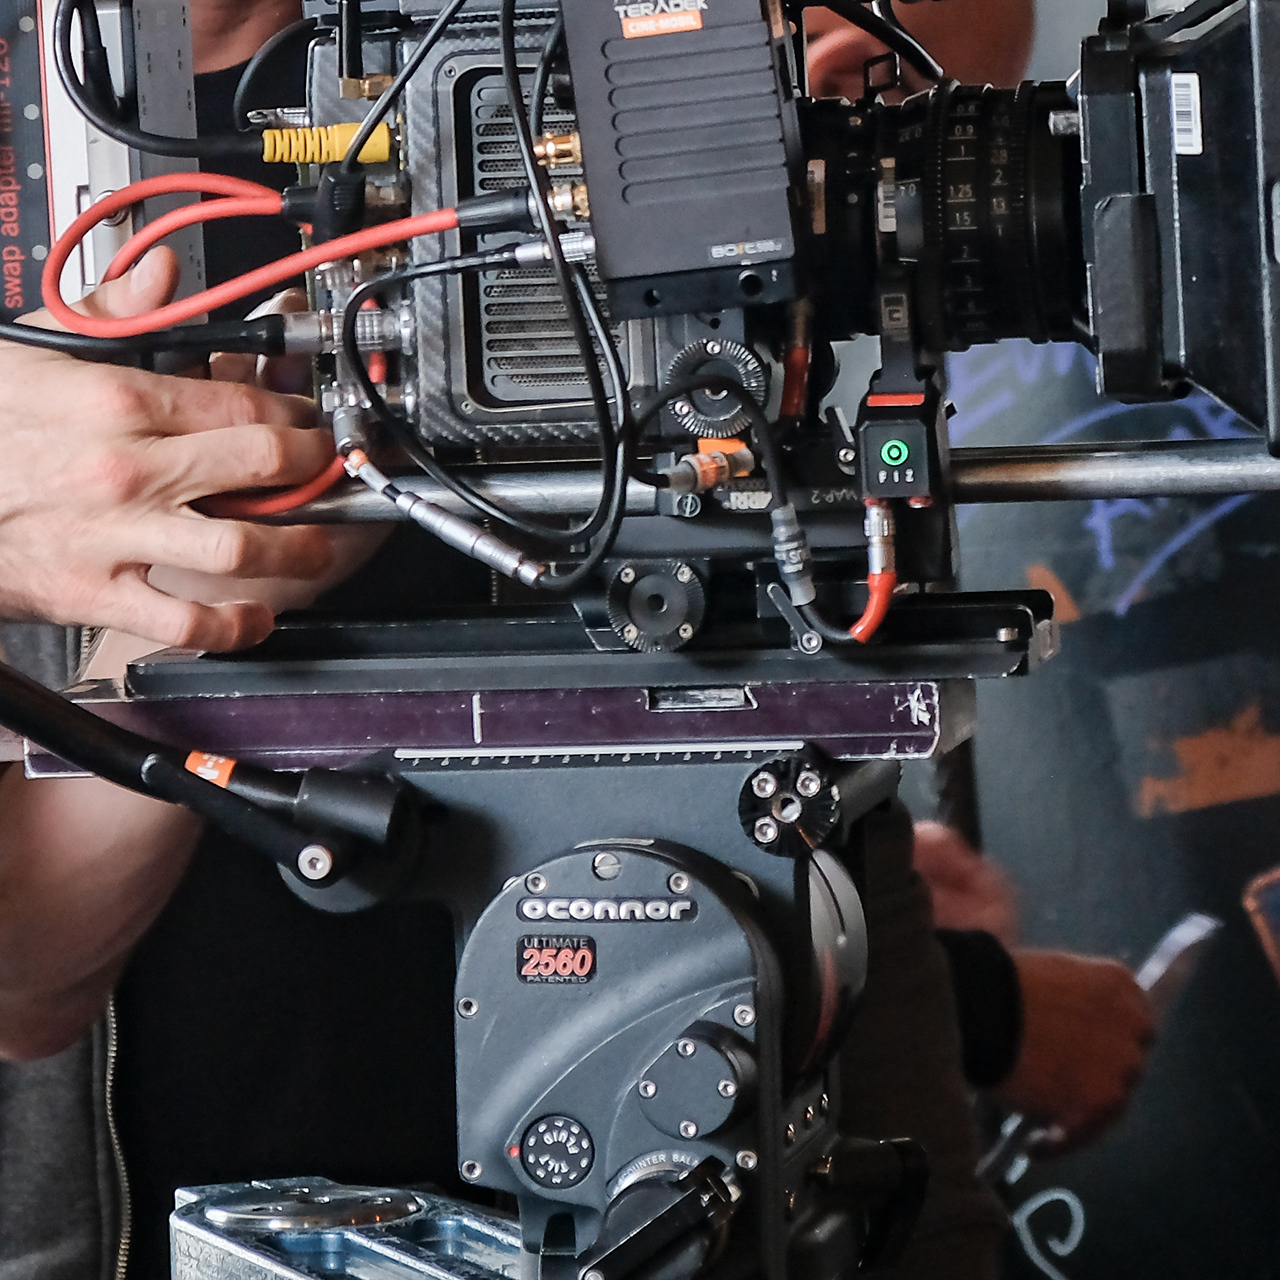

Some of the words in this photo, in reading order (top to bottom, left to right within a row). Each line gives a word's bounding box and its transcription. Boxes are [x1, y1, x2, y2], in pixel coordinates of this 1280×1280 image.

[627, 14, 697, 34] CINE-MOBIL
[2, 245, 27, 308] swap
[522, 898, 691, 920] oconnor
[524, 937, 588, 949] ULTIMATE
[521, 948, 593, 976] 2560
[526, 975, 588, 984] PATENTED
[538, 1153, 570, 1174] TILT
